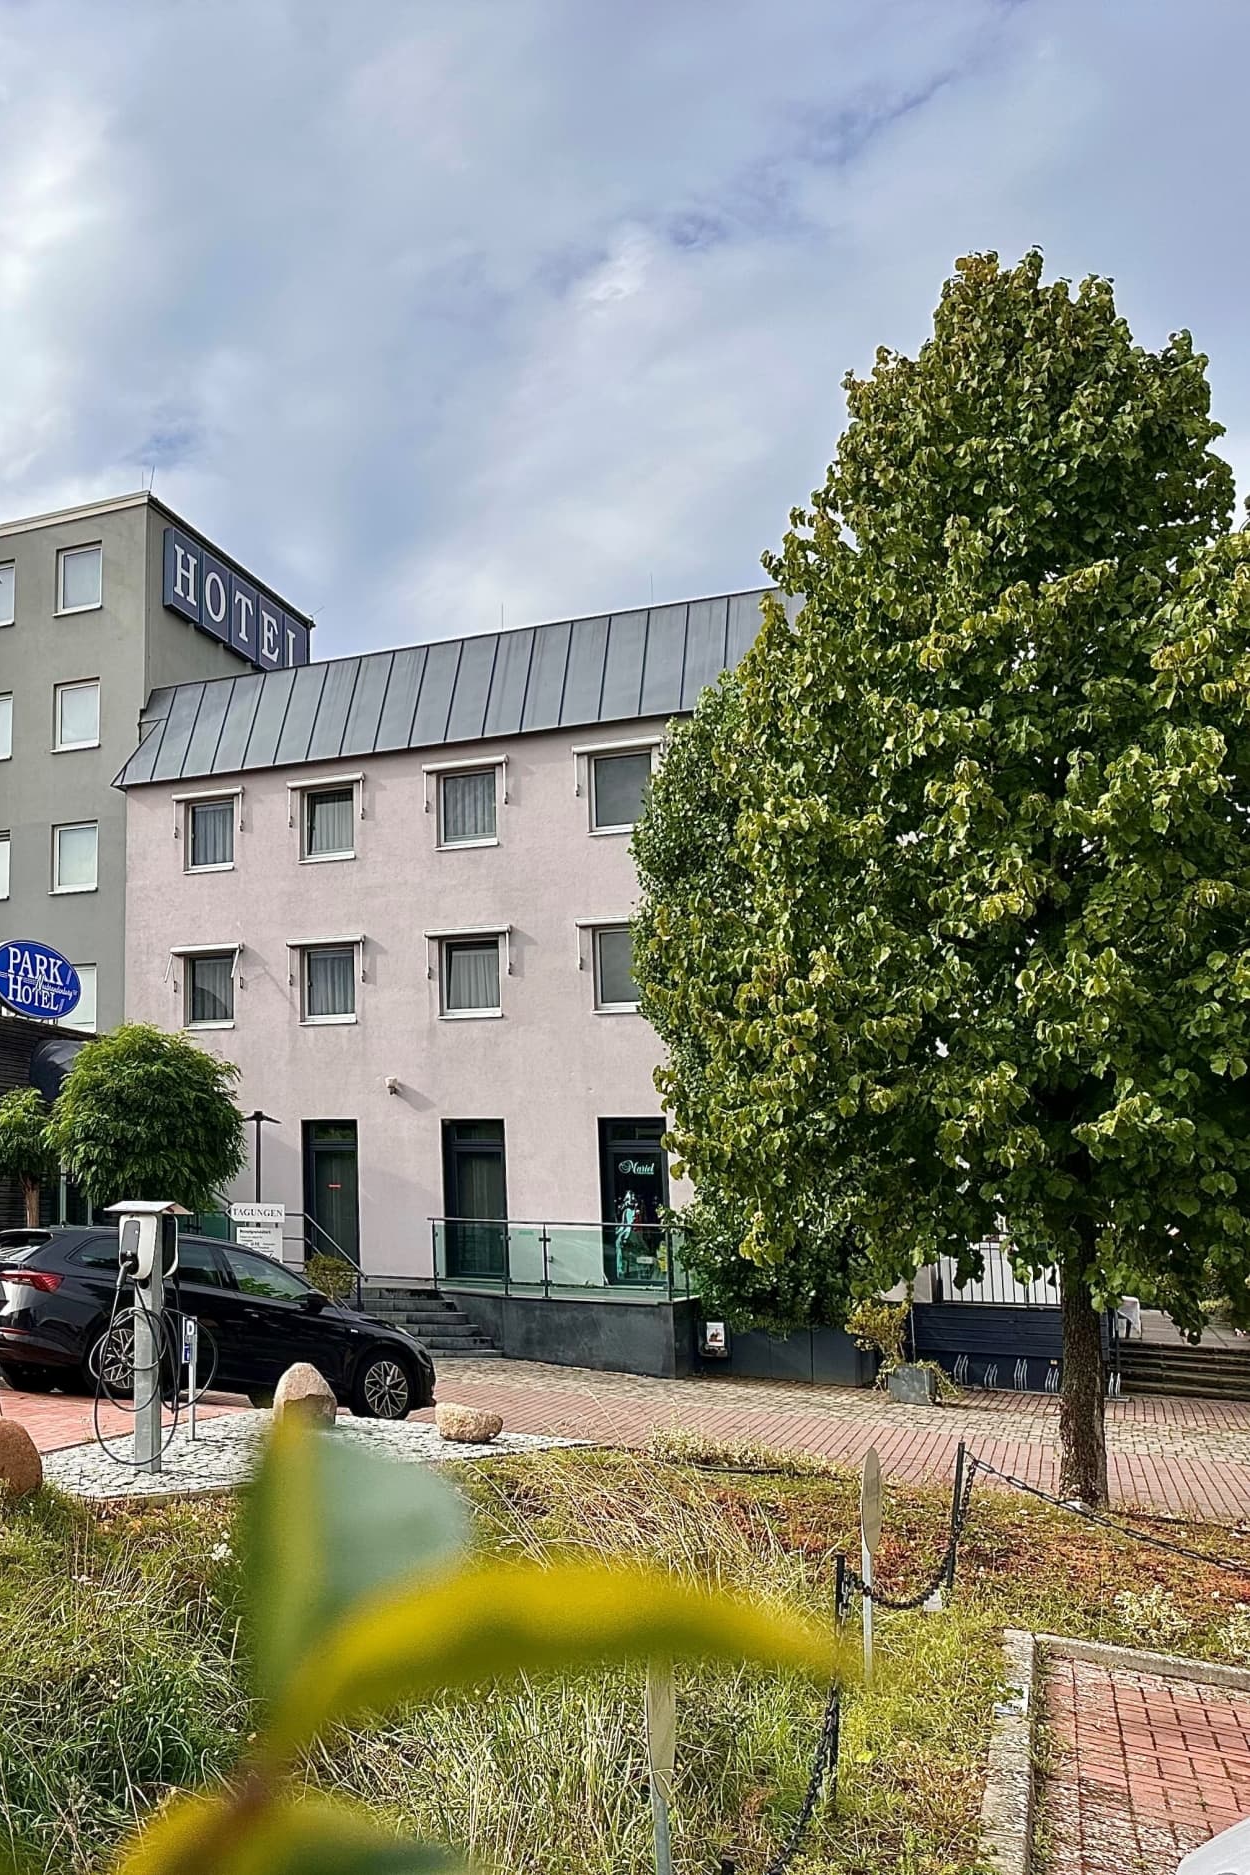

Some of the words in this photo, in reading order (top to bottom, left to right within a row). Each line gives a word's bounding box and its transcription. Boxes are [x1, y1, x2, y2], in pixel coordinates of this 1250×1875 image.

[174, 544, 296, 668] HOTEL
[7, 947, 64, 986] PARK
[6, 973, 59, 1011] HOTEL
[233, 1208, 283, 1217] TAGUNGEN
